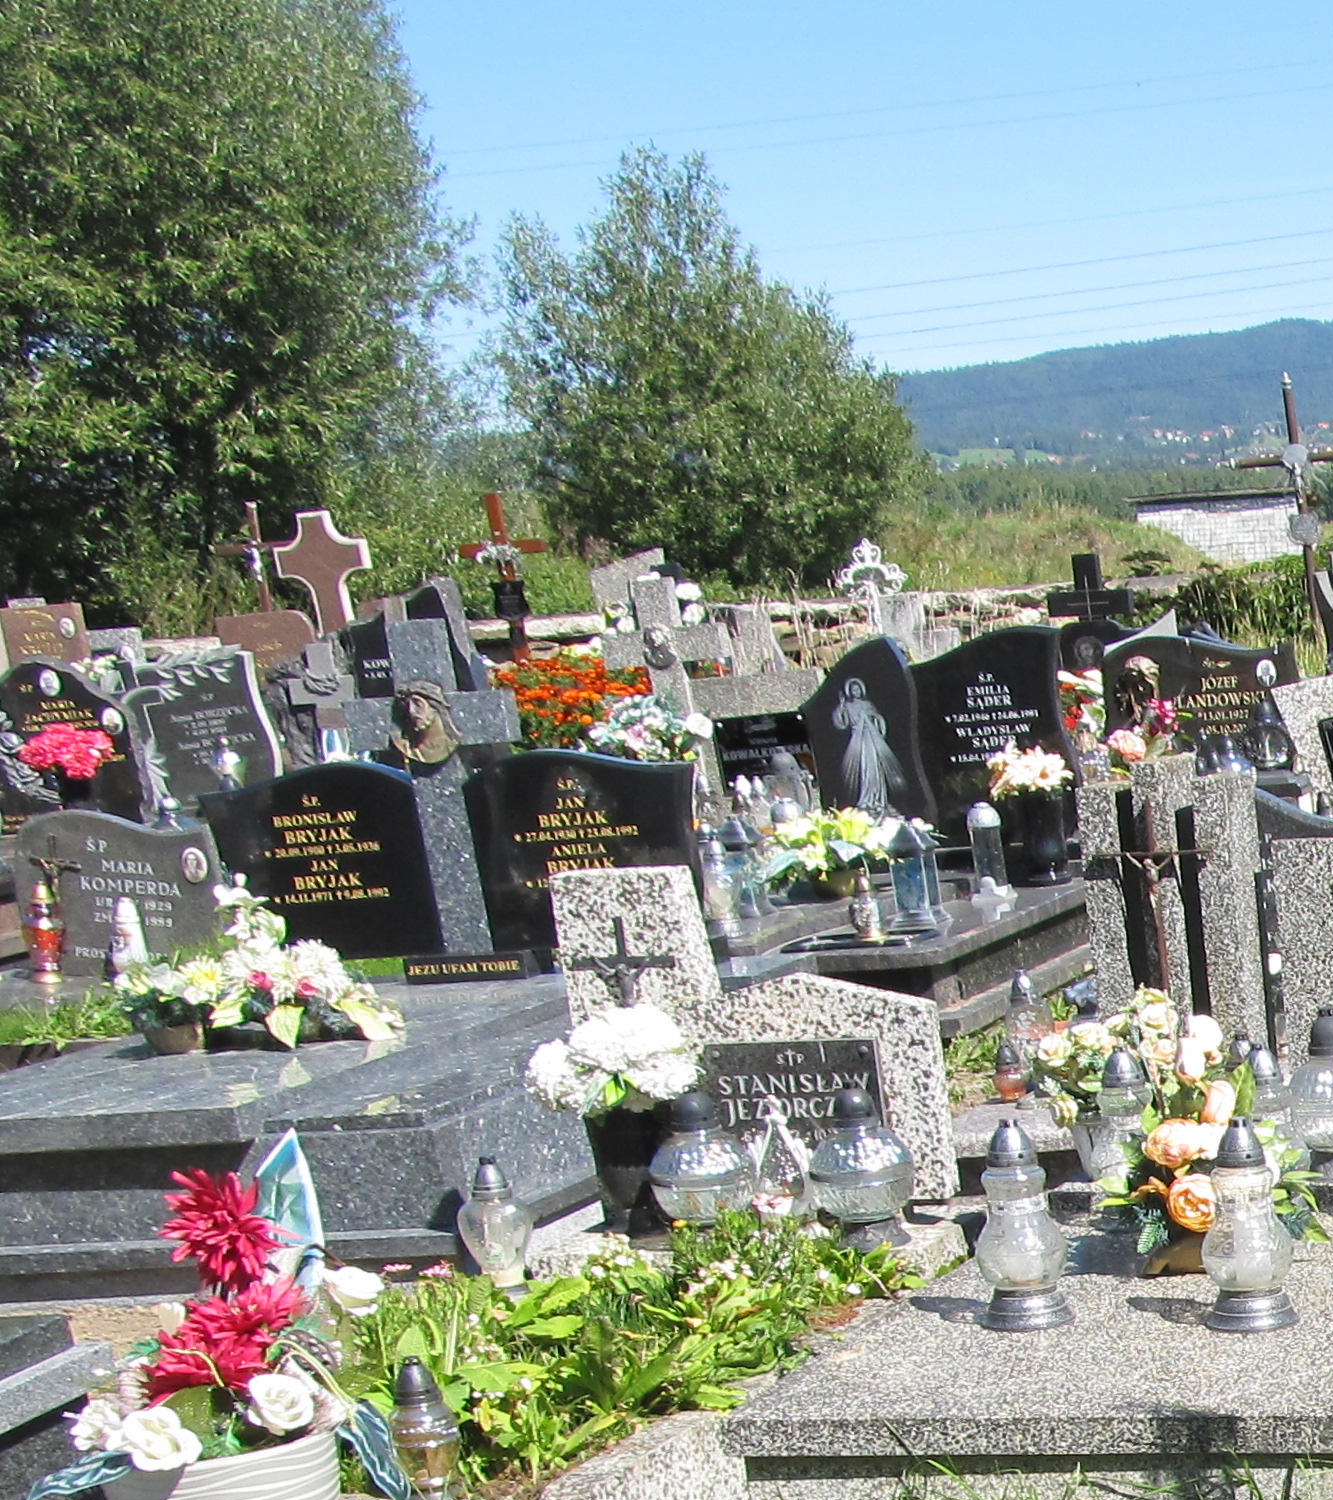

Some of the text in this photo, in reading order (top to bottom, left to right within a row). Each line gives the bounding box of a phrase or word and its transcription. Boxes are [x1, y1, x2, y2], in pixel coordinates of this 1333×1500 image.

[1200, 674, 1239, 692] JÓZEF
[1174, 690, 1267, 709] LANDOWSKI
[721, 743, 811, 762] KOWALKOSKA
[555, 796, 585, 810] JAN
[537, 810, 609, 829] BRYJAK
[283, 826, 355, 845] BRYJAK
[552, 842, 608, 858] ANIELA
[101, 859, 154, 877] MARIA
[310, 858, 340, 873] JAN
[80, 876, 183, 899] KOMPERDA
[292, 872, 365, 891] BRYJAK
[407, 960, 520, 976] JEZU UFAM TOBIE
[717, 1071, 869, 1097] STANISŁAW
